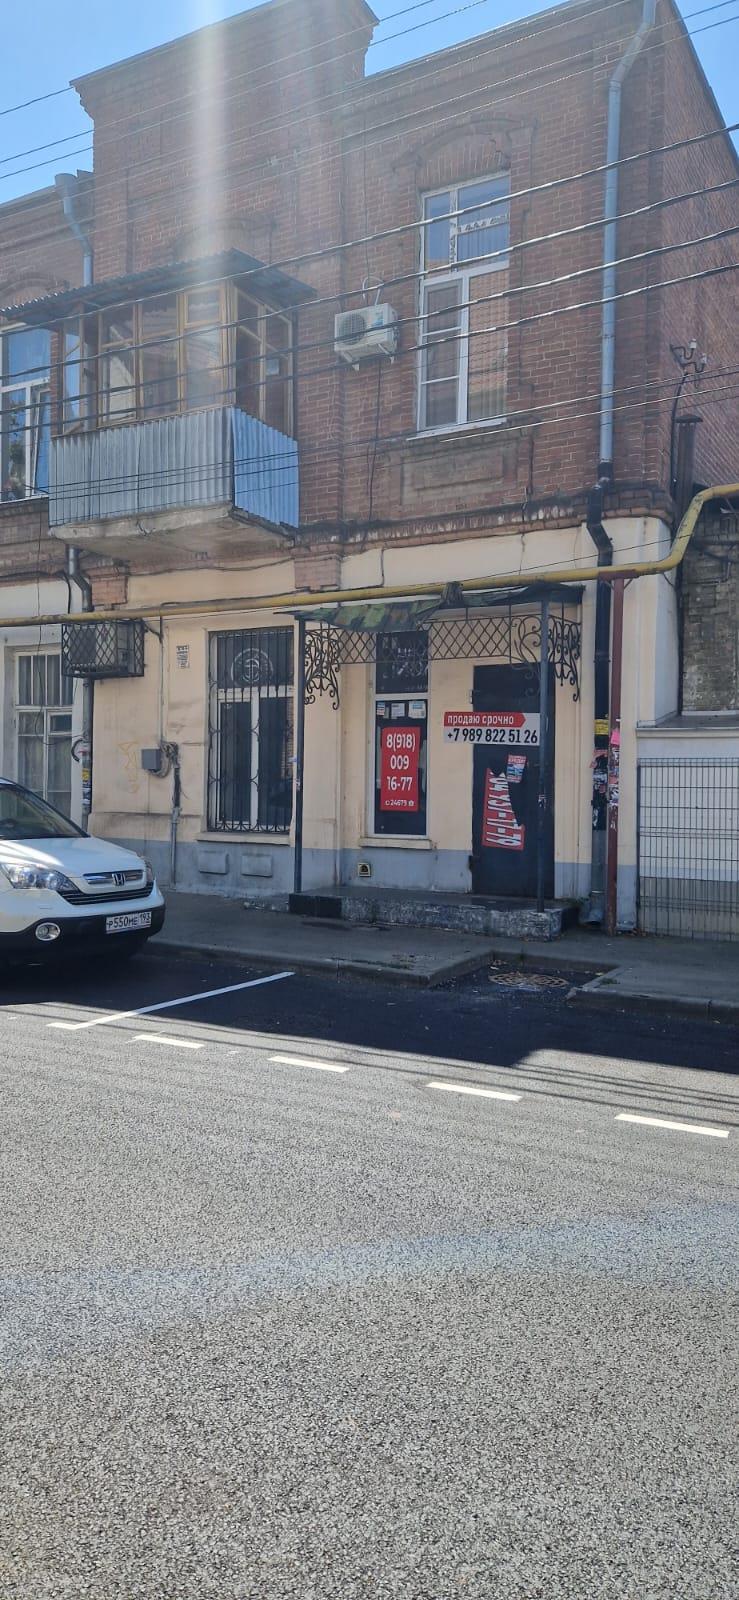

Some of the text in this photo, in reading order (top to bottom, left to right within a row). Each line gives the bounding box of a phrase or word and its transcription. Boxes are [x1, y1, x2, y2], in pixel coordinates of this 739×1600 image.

[447, 715, 514, 727] продаю срочно
[386, 733, 416, 752] 8(918)
[447, 728, 538, 744] +7 989 822 51 26
[390, 755, 409, 770] 009
[386, 776, 413, 791] 16-77
